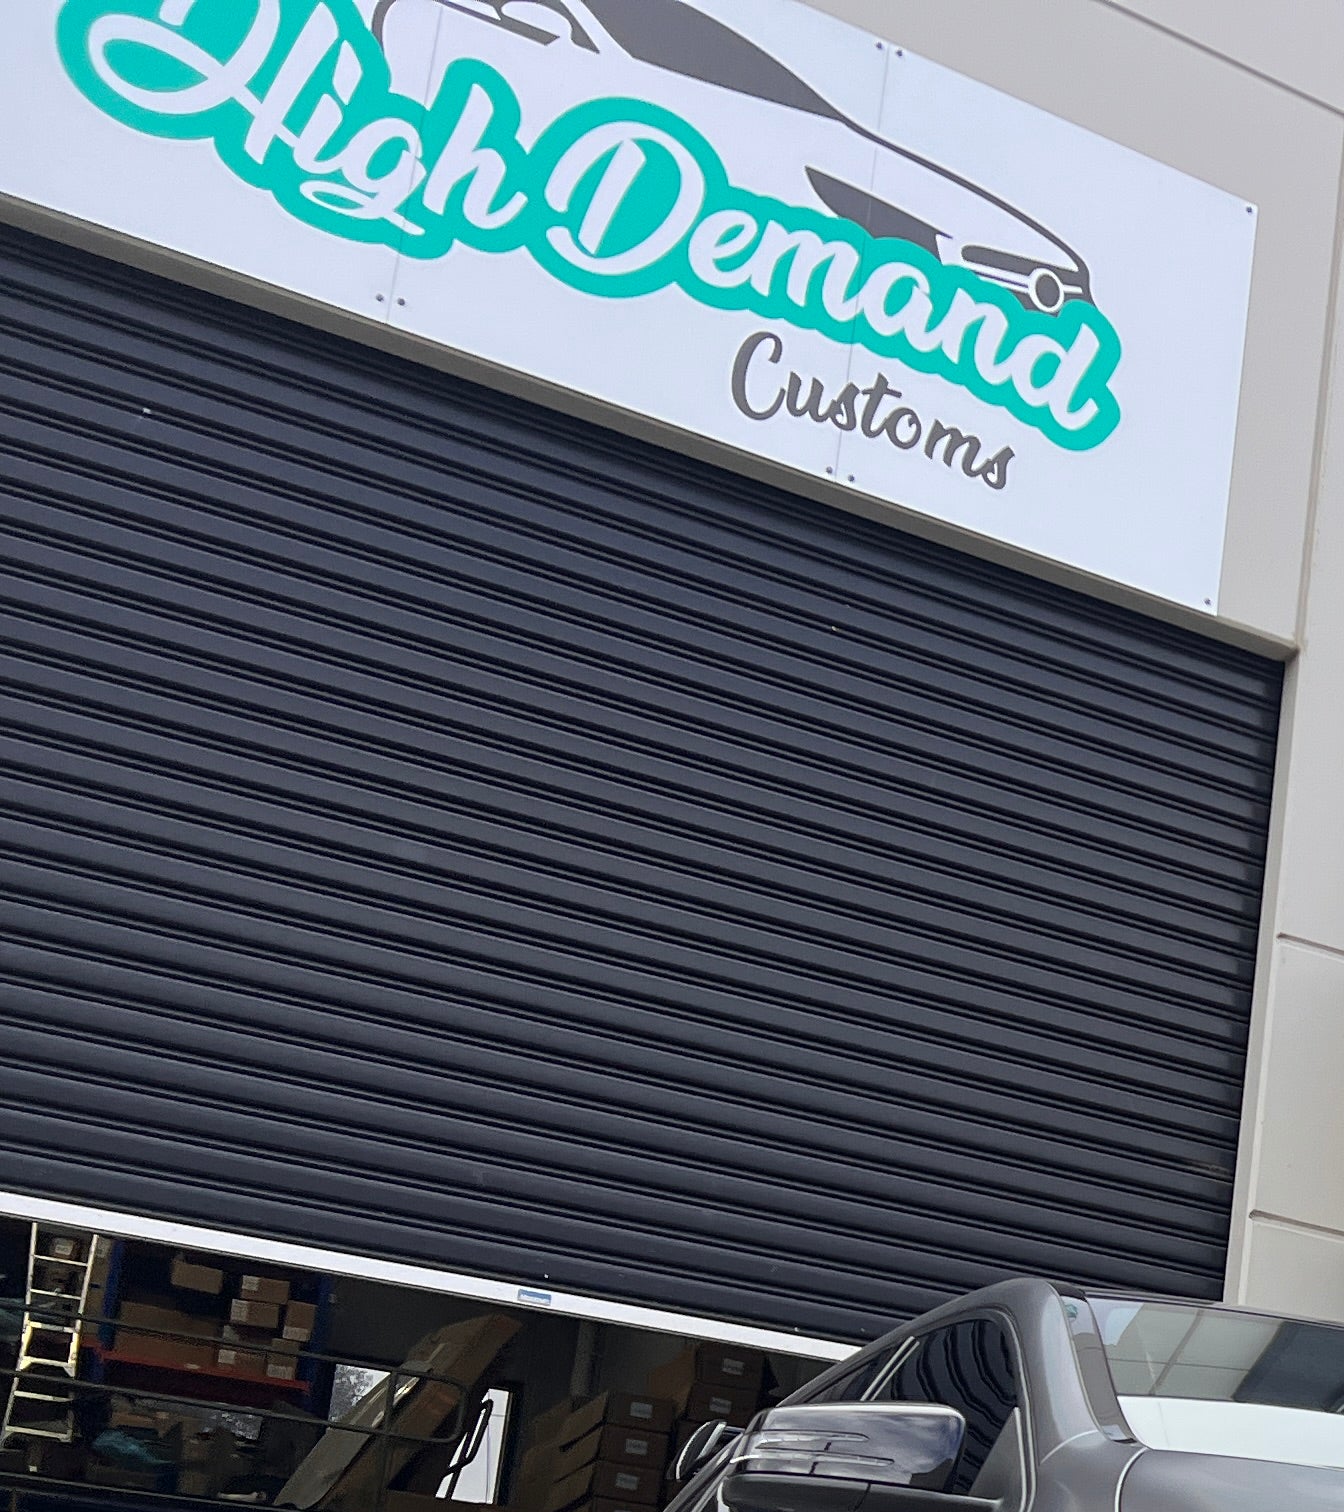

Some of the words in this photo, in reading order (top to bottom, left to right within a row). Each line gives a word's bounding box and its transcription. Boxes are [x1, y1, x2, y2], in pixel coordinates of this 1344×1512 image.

[85, 0, 529, 237] High
[542, 120, 1101, 430] Demand
[730, 331, 1016, 490] Customs
